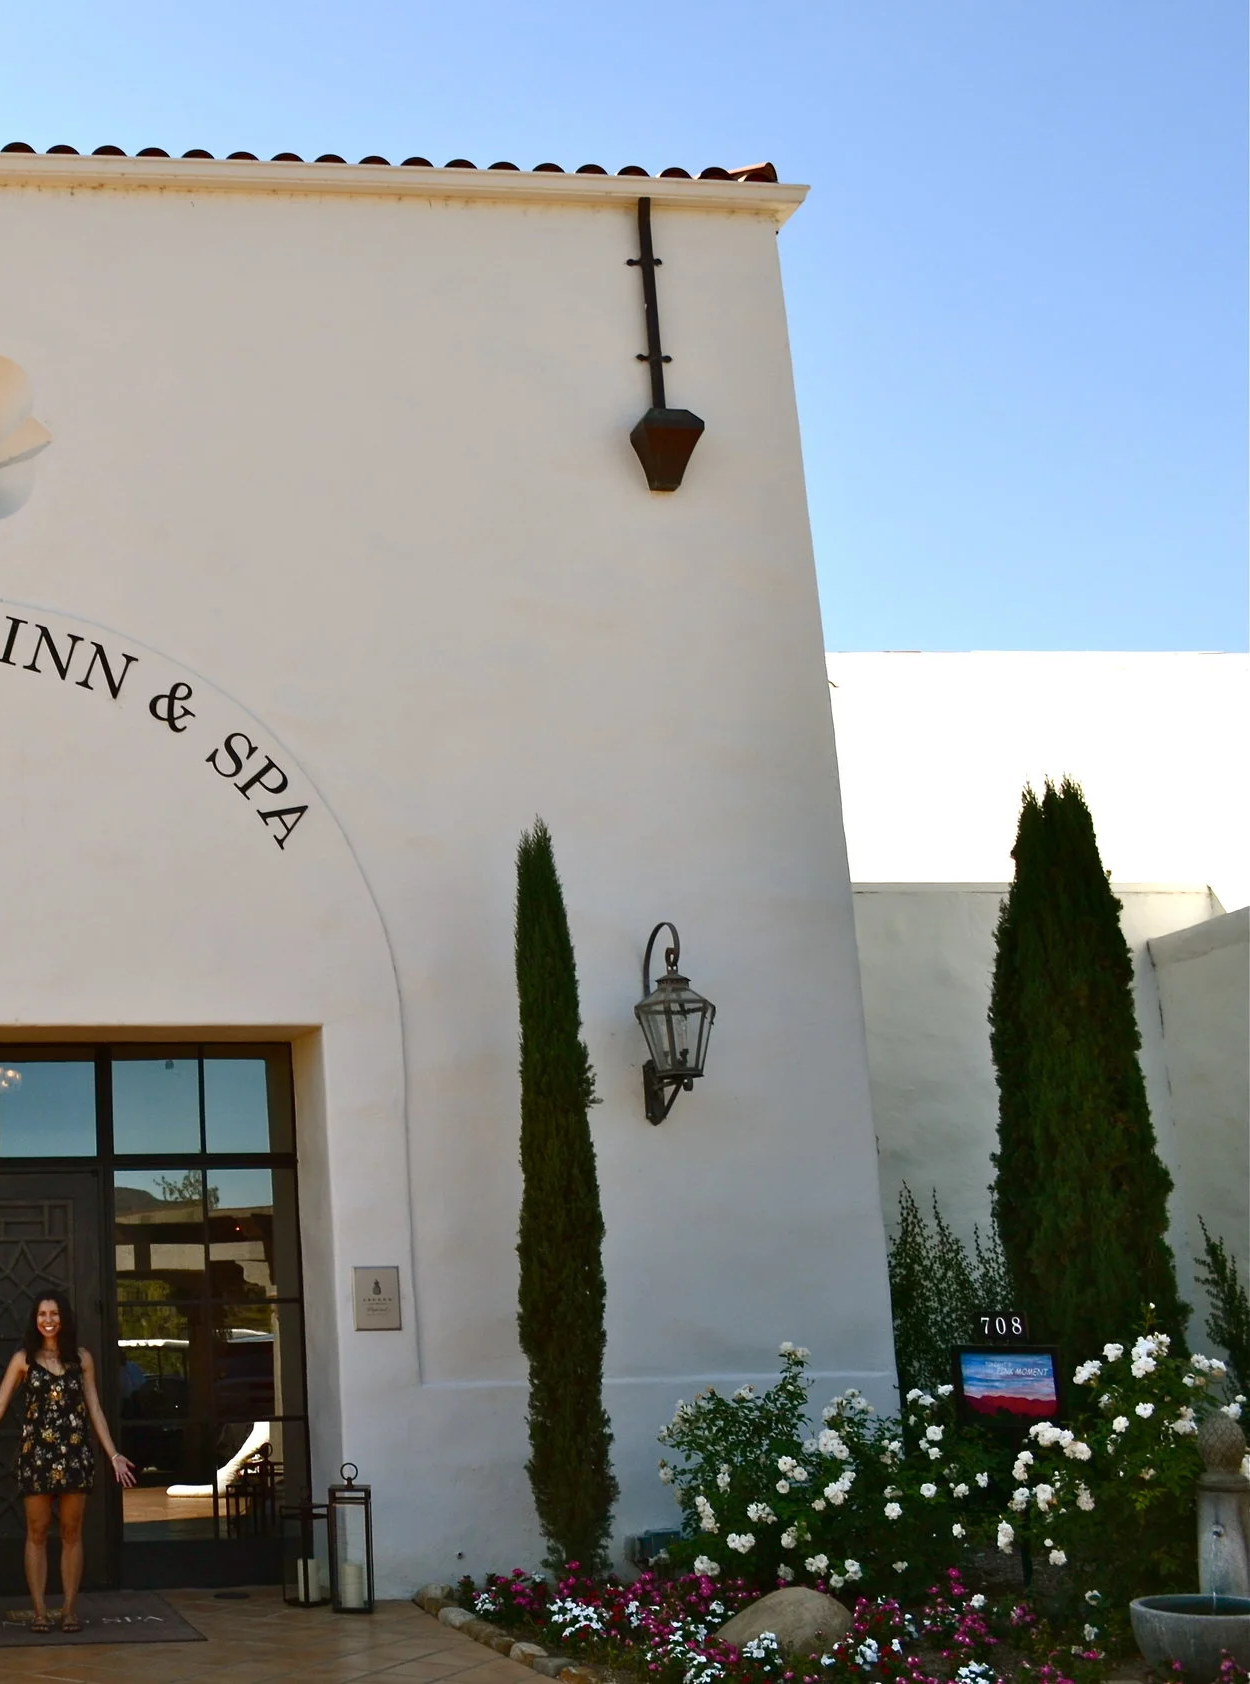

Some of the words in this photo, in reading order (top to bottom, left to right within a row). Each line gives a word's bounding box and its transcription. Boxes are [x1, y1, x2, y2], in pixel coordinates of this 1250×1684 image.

[148, 682, 196, 734] &
[205, 732, 309, 851] SPA
[980, 1316, 1022, 1335] 708
[1014, 1368, 1049, 1377] MOMENT
